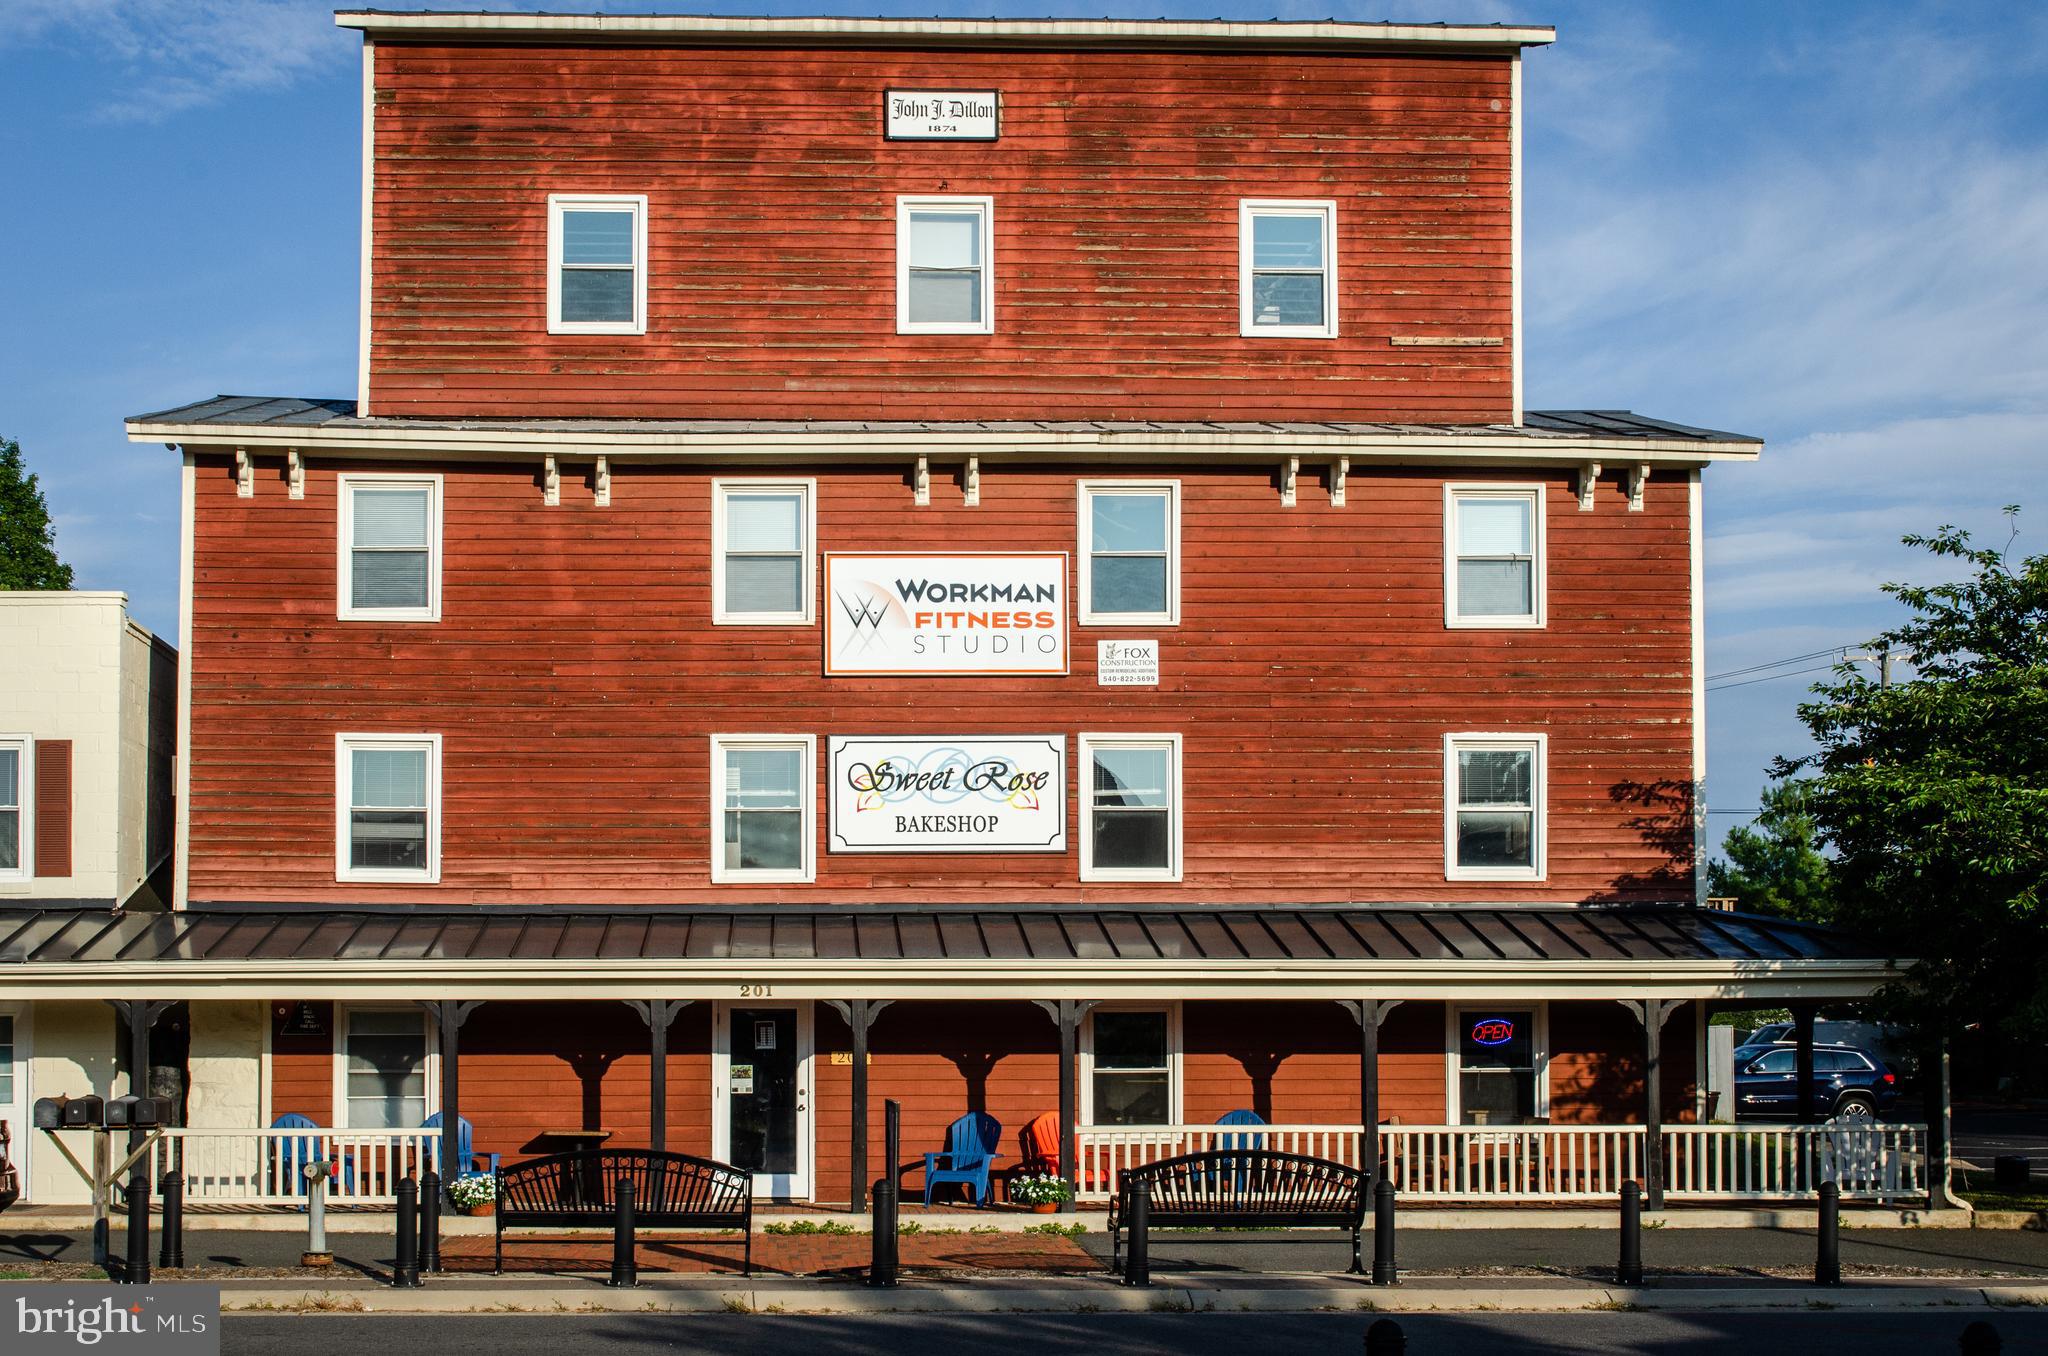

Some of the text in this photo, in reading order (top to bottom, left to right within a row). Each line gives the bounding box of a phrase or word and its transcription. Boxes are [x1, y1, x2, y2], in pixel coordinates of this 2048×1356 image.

[893, 99, 993, 120] John J. Dillon
[895, 579, 1055, 603] WORKMAN
[915, 611, 1055, 629] FITNESS
[914, 634, 1056, 654] STUDIO
[1124, 648, 1150, 658] FOX
[848, 761, 1049, 792] Sweet Rose
[895, 815, 999, 833] BAKESHOP
[740, 984, 773, 997] 201
[1472, 1023, 1514, 1041] OPEN
